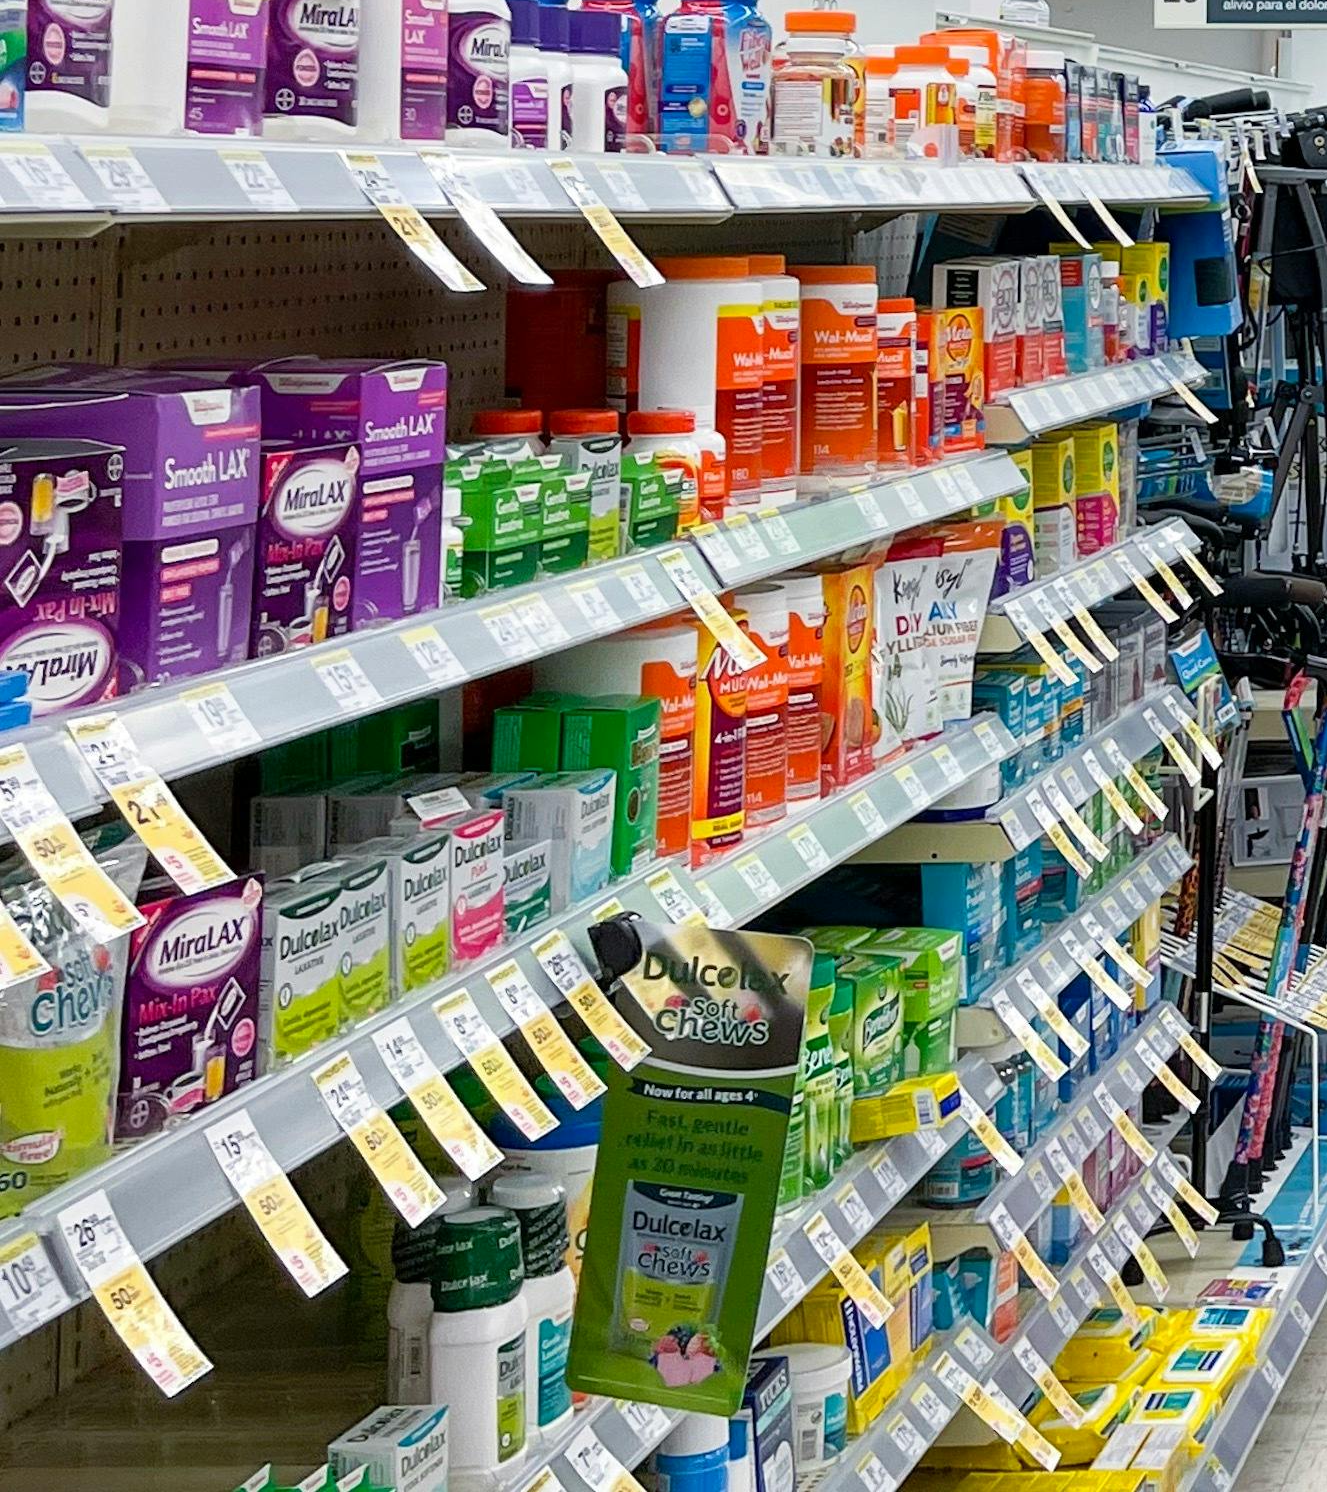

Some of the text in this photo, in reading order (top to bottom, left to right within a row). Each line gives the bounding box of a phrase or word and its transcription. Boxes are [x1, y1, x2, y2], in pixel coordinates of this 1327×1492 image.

[300, 3, 357, 27] MiraLA
[1256, 0, 1283, 13] para
[365, 412, 436, 444] Smooth LAX
[165, 448, 250, 491] Smooth LAX
[284, 476, 349, 510] MiraLAX
[454, 831, 503, 867] Dulcolax
[403, 864, 448, 901] Dulcolax
[339, 890, 388, 931] Dulcolax
[158, 916, 247, 966] MiraLAX
[279, 918, 340, 961] Dulcolax
[655, 1007, 769, 1045] Chews
[643, 1083, 673, 1098] Now
[675, 1086, 695, 1099] for
[696, 1087, 712, 1100] all
[714, 1089, 743, 1102] ages
[692, 1116, 749, 1137] gentle
[633, 1212, 727, 1244] Dulcolax
[637, 1251, 711, 1279] Chews
